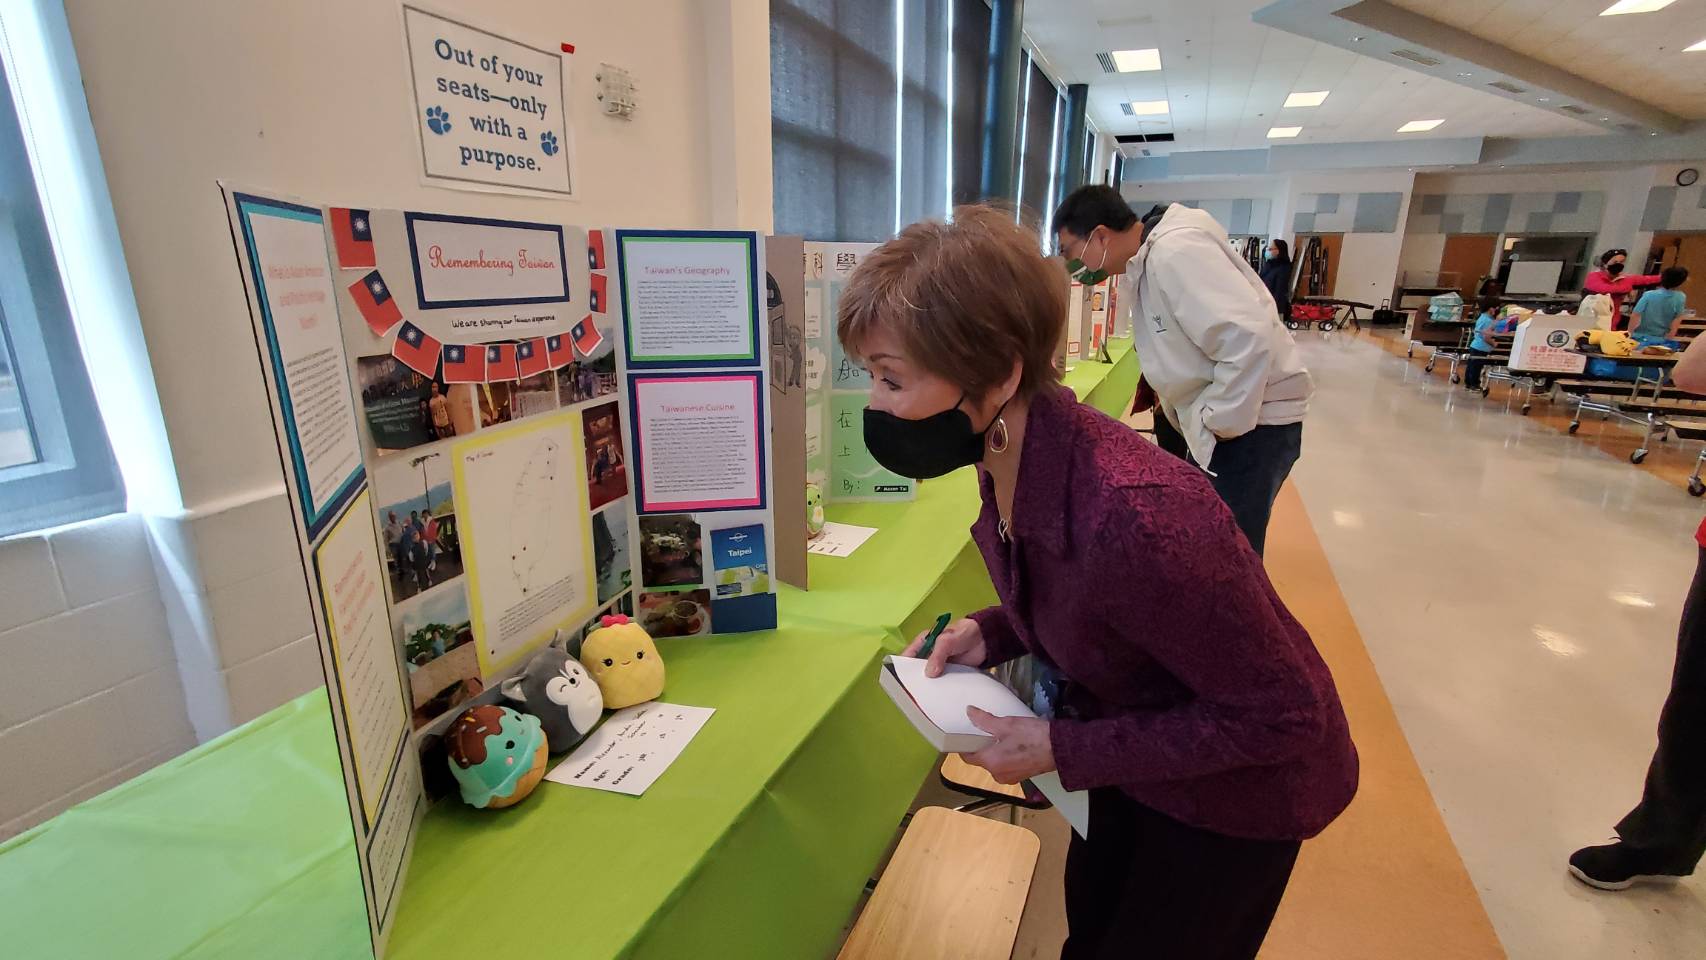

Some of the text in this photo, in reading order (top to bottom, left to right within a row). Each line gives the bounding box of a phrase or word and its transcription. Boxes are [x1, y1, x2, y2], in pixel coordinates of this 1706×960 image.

[434, 38, 544, 87] Out of your
[469, 114, 528, 141] with a
[459, 145, 542, 172] purpose.
[428, 245, 556, 277] Remembering Taiwan
[644, 266, 730, 276] Taiwan's Geography
[451, 320, 465, 328] We
[465, 320, 478, 328] are
[660, 402, 736, 413] Taiwanese Cuisine
[728, 547, 753, 557] Taipei
